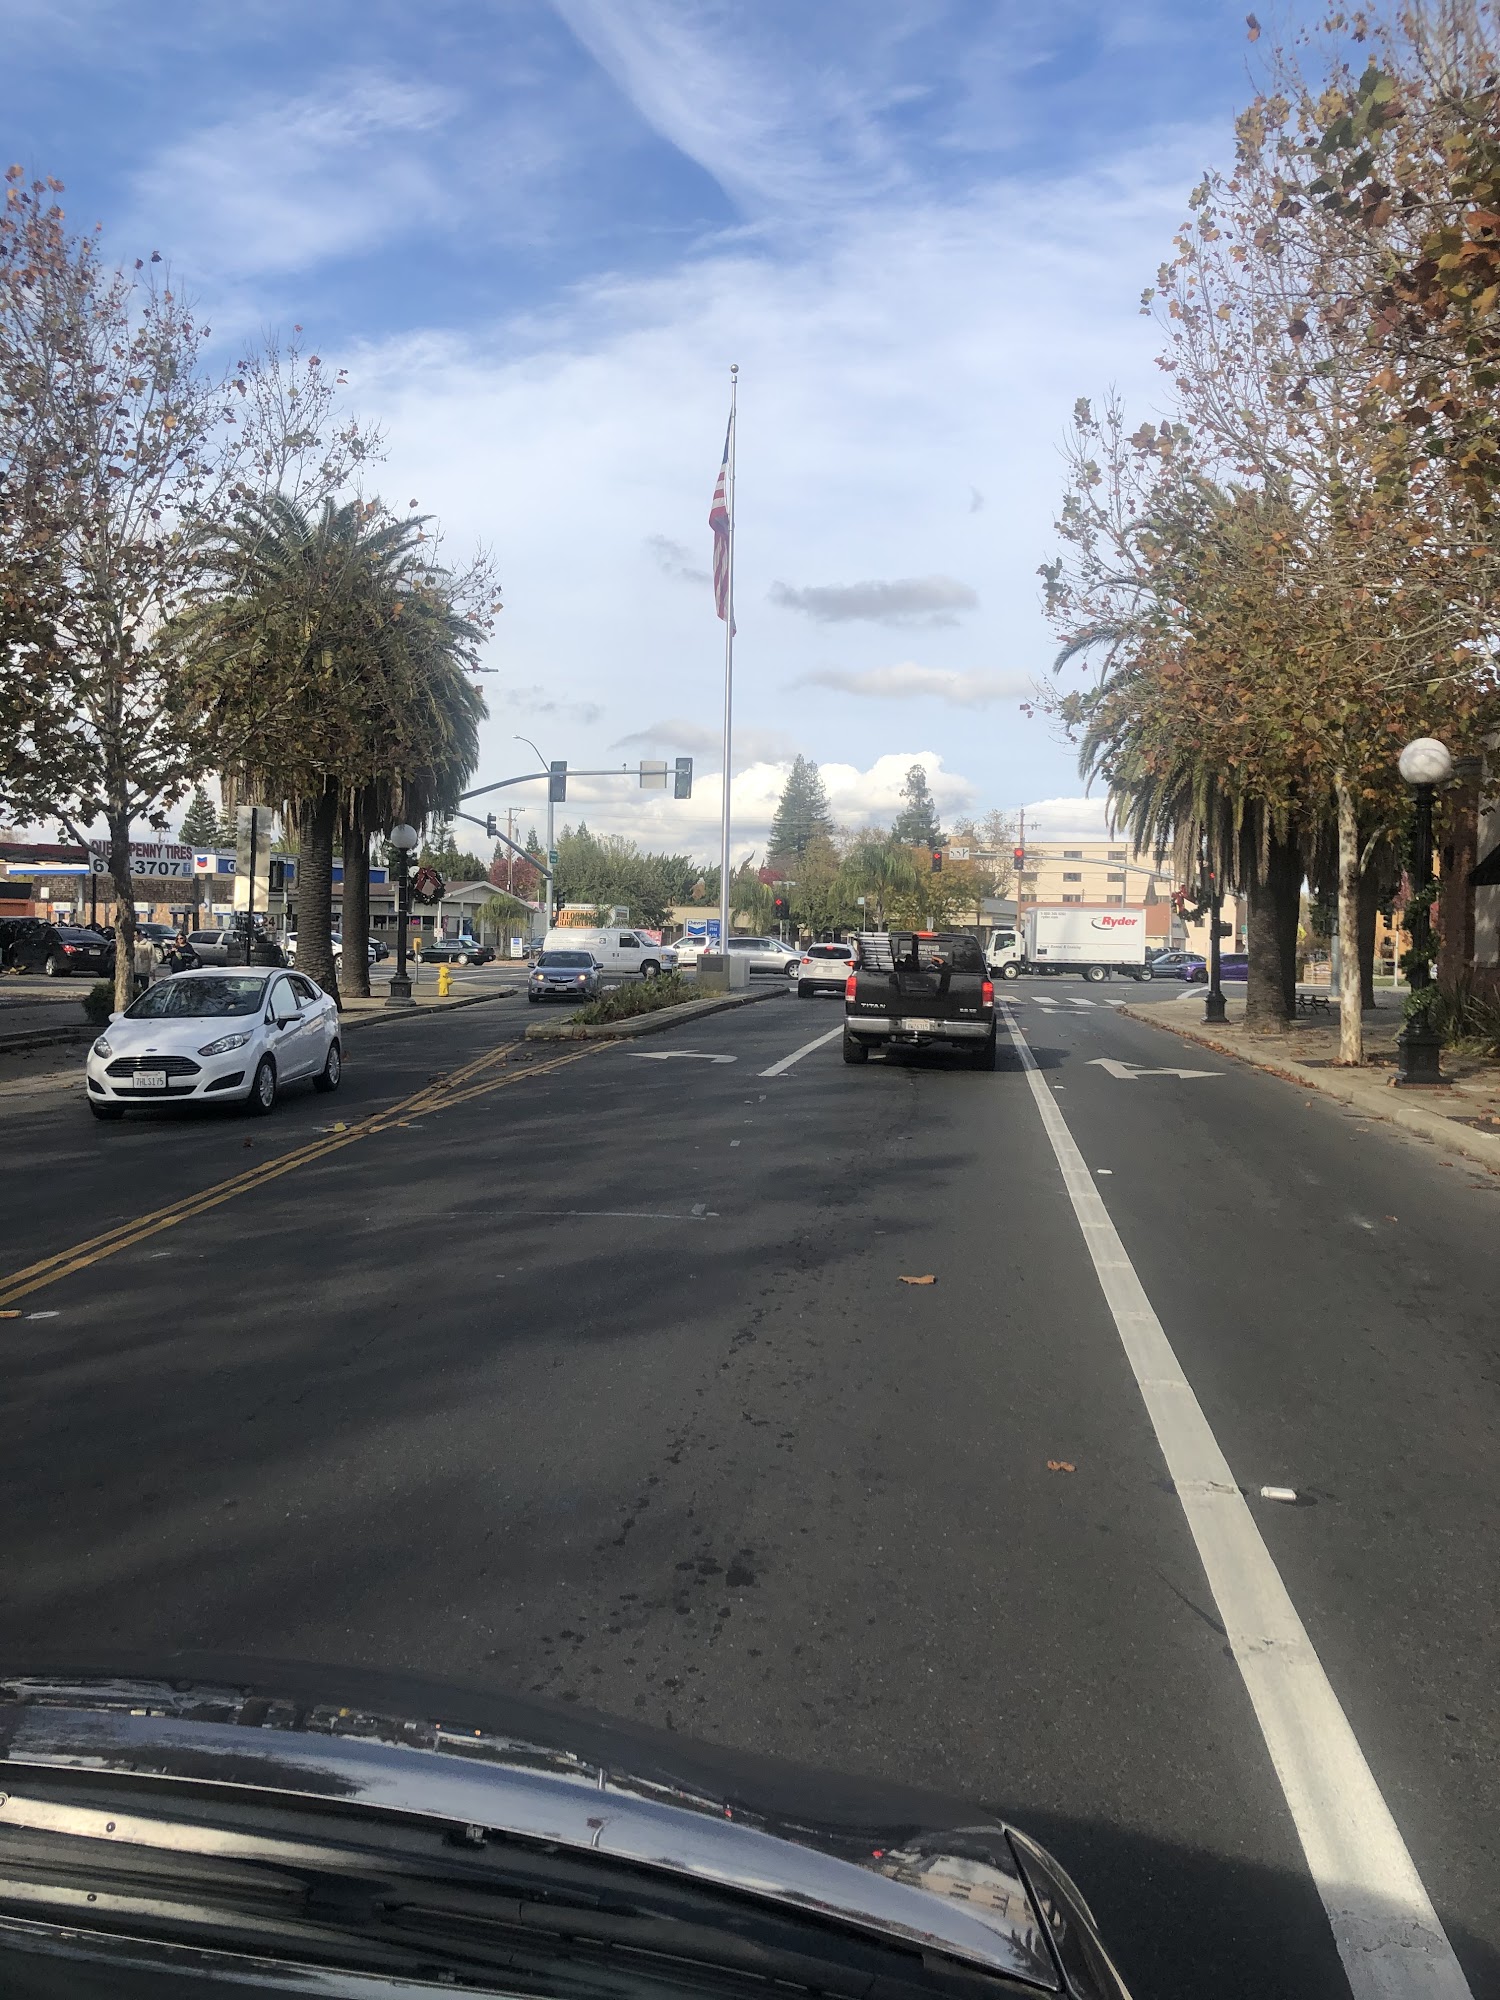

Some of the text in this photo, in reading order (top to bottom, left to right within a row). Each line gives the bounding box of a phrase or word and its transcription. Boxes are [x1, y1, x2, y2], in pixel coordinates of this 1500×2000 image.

[129, 842, 163, 858] PENNY
[165, 845, 193, 860] TIRES
[1102, 916, 1138, 927] Ryder
